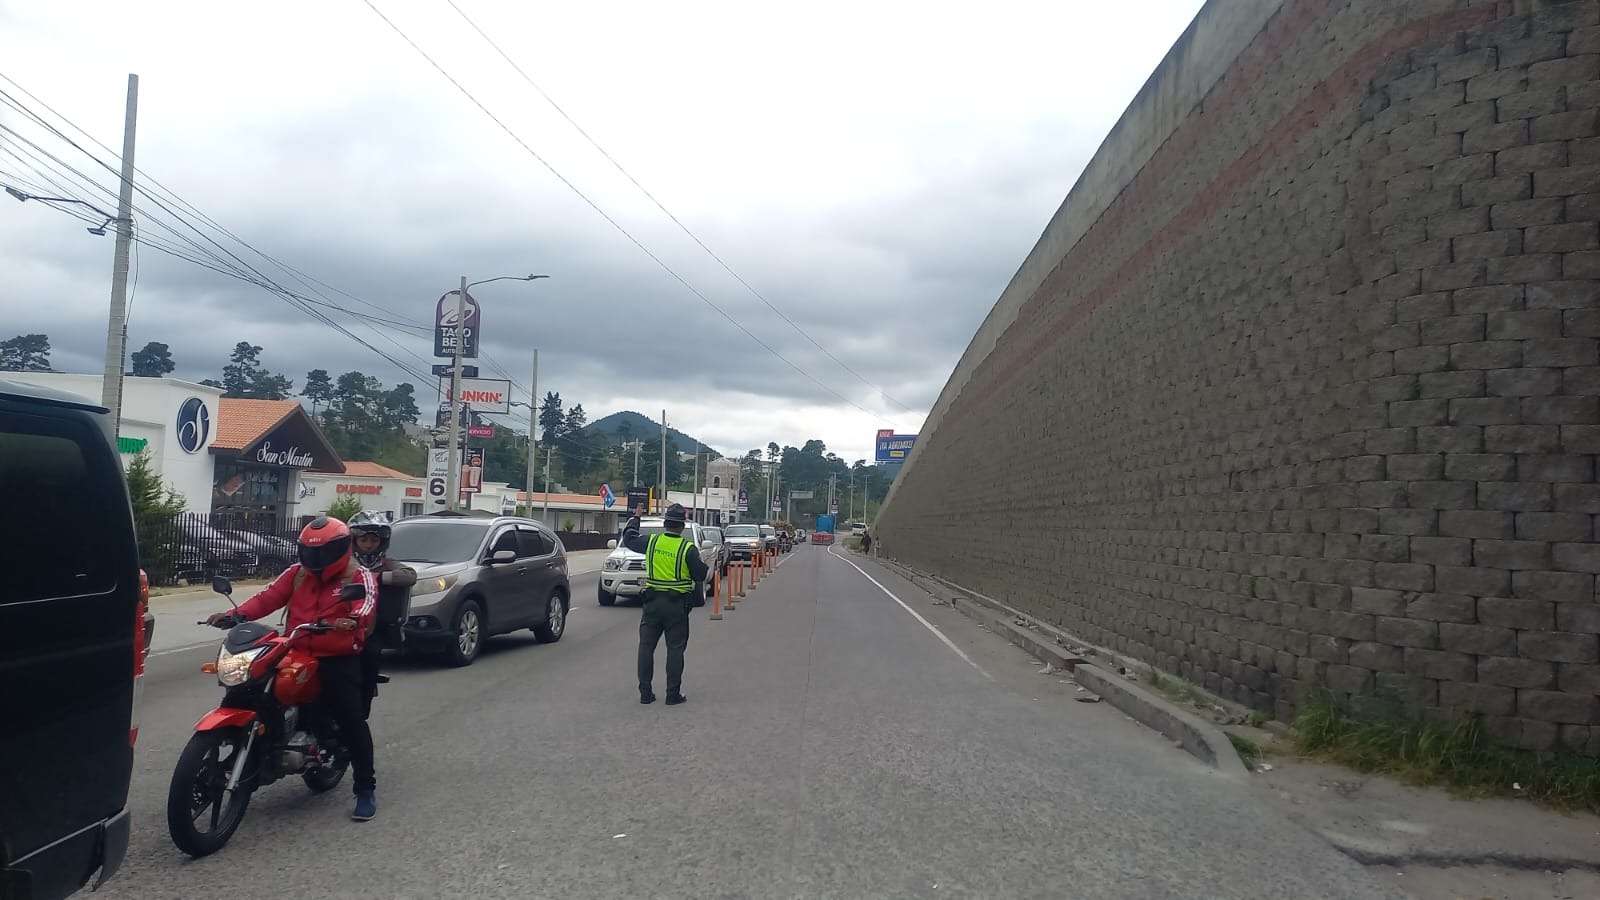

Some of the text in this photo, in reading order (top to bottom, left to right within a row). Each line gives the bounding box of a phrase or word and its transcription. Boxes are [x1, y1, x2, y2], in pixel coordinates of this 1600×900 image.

[442, 337, 470, 347] BEL
[257, 441, 279, 463] San
[430, 478, 445, 497] 6
